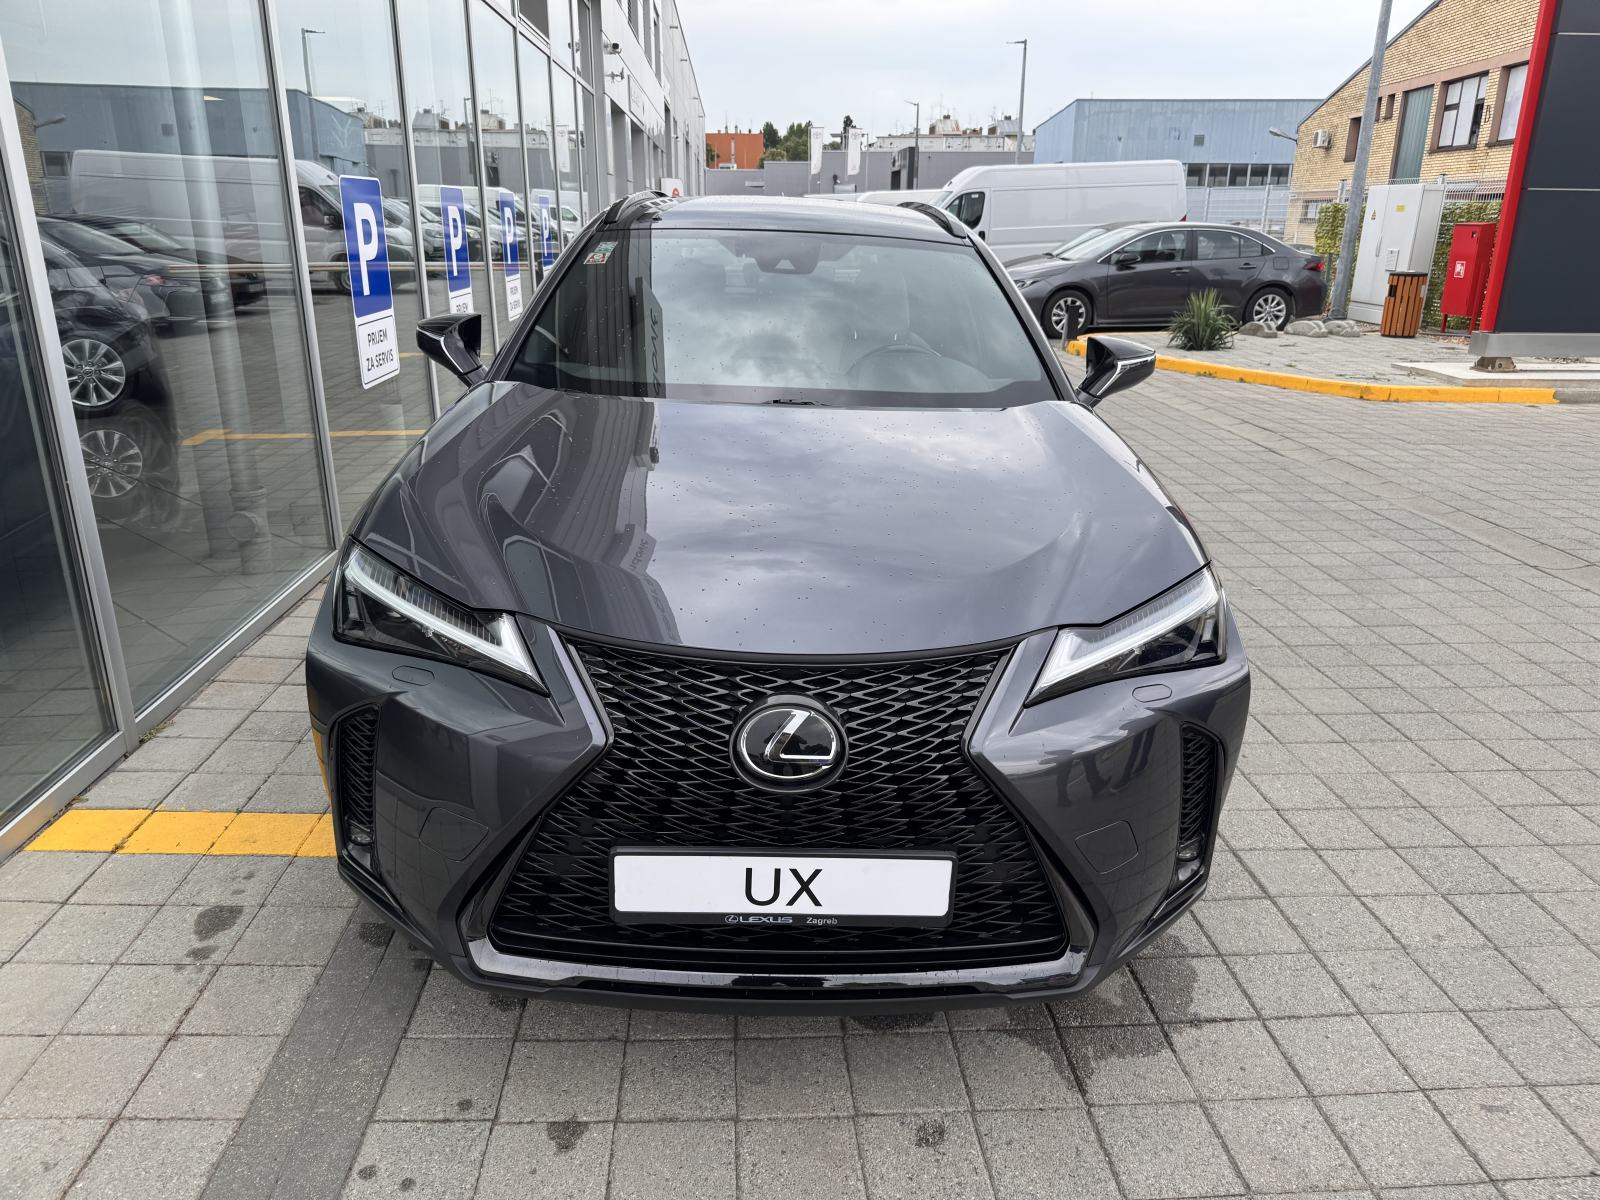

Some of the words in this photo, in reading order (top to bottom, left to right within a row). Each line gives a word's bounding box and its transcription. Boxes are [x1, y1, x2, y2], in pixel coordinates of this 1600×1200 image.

[353, 203, 379, 296] P
[447, 206, 462, 277] P
[504, 207, 514, 264] P
[541, 208, 549, 257] P
[367, 328, 388, 347] PRIJEM
[366, 356, 375, 371] ZA
[375, 349, 393, 368] SERVIS
[745, 867, 823, 907] UX
[740, 916, 793, 924] LEXUS
[806, 917, 838, 926] Zagreb
